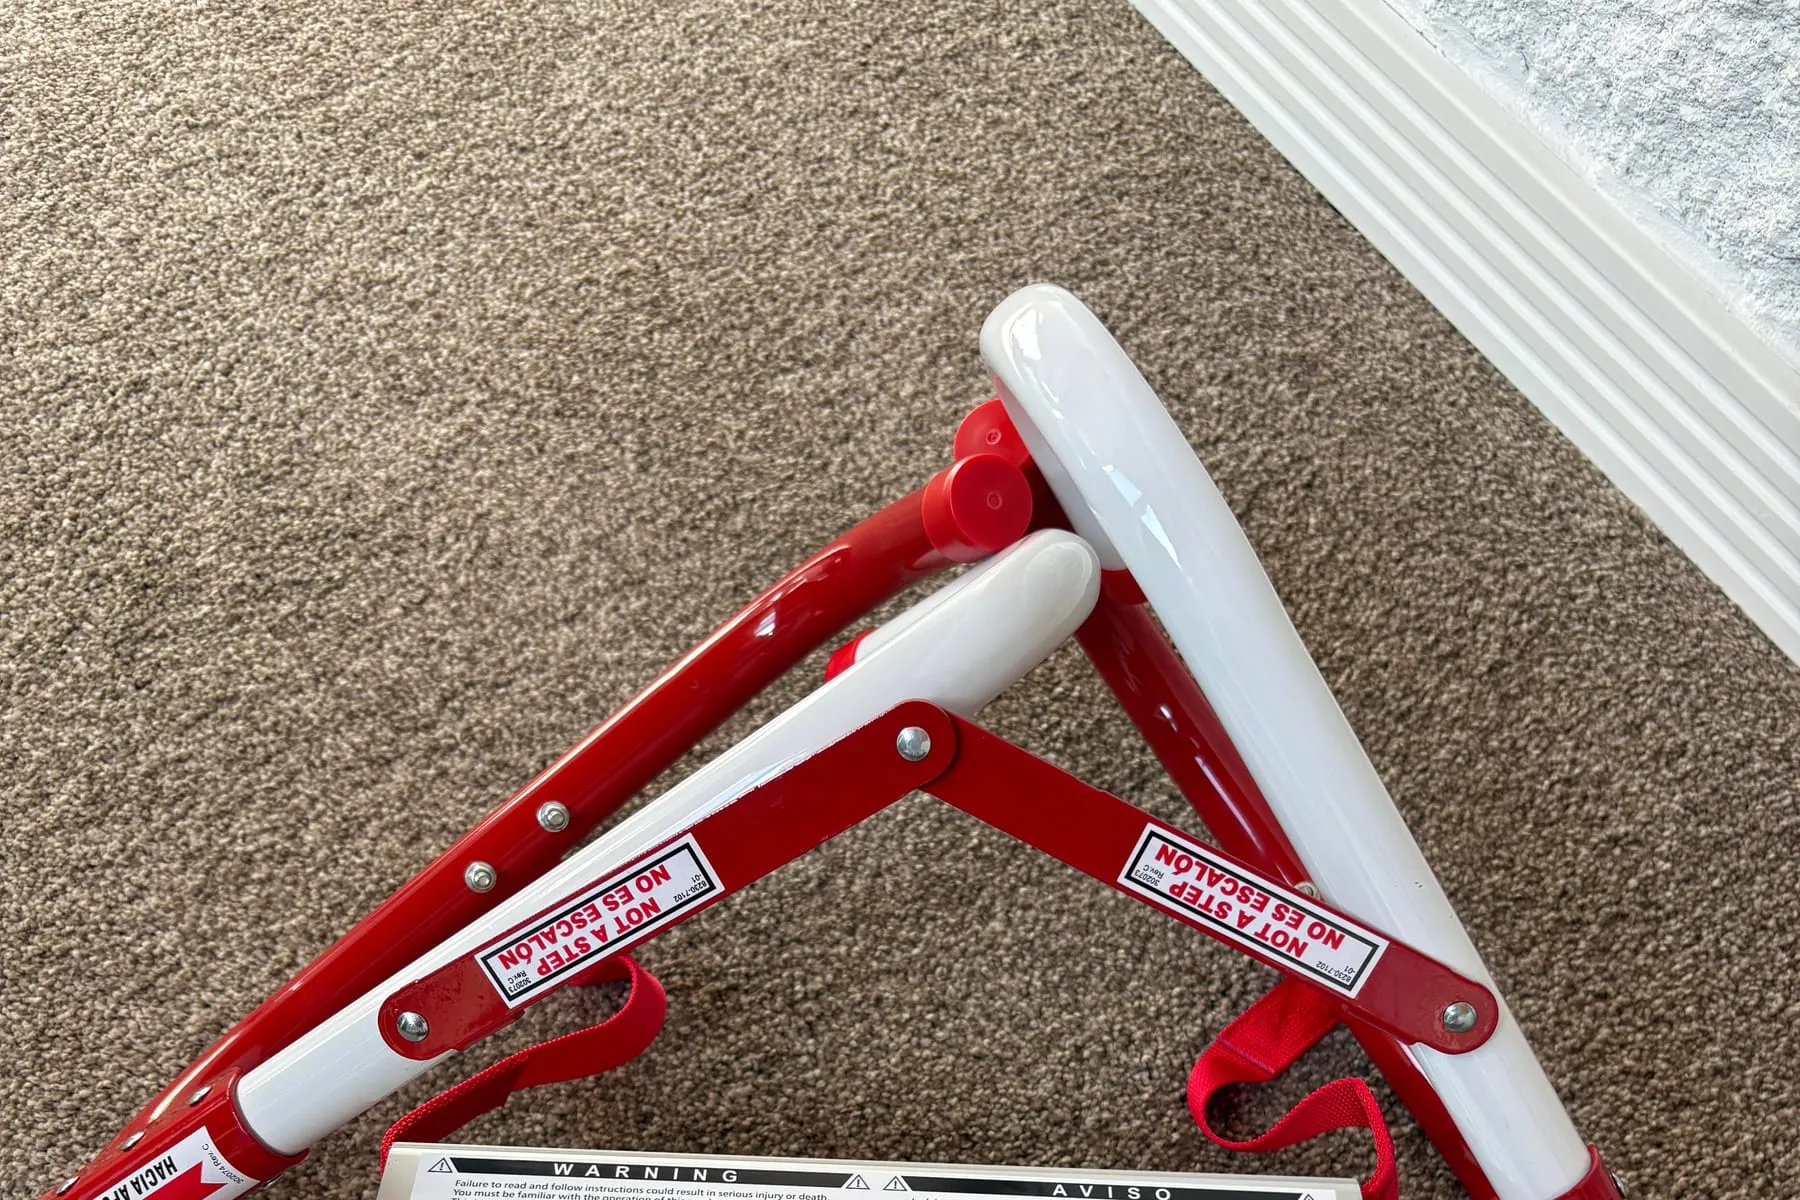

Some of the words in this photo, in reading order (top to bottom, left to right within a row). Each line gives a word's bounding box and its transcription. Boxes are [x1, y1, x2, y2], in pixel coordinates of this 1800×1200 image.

[636, 865, 670, 893] NO
[1135, 869, 1159, 886] 302073
[1155, 844, 1270, 912] ESCALÓN
[602, 886, 634, 911] ES
[674, 880, 707, 902] 8230-7102
[1169, 882, 1232, 919] STEP
[616, 898, 660, 934] NOT
[1237, 911, 1254, 929] A
[1272, 904, 1305, 930] ES
[498, 904, 601, 969] ESCALÓN
[592, 925, 608, 943] A
[1255, 927, 1308, 957] NOT
[1308, 922, 1344, 949] NO
[538, 937, 591, 976] STEP
[1316, 960, 1352, 982] 8230-7102
[508, 976, 531, 993] 302073
[133, 1156, 177, 1194] HACIA
[550, 1163, 742, 1182] WARNING
[452, 1188, 472, 1197] You
[473, 1190, 501, 1198] must
[502, 1190, 516, 1199] be
[517, 1190, 557, 1200] familiar
[558, 1192, 582, 1200] with
[454, 1179, 490, 1189] Failure
[490, 1181, 503, 1189] to
[503, 1181, 528, 1190] read
[528, 1182, 549, 1191] and
[550, 1182, 584, 1192] follow
[584, 1184, 645, 1195] instructions
[645, 1187, 675, 1196] could
[675, 1188, 705, 1197] result
[706, 1189, 716, 1197] in
[718, 1189, 754, 1199] serious
[785, 1193, 797, 1200] or
[1049, 1182, 1175, 1200] AVISO
